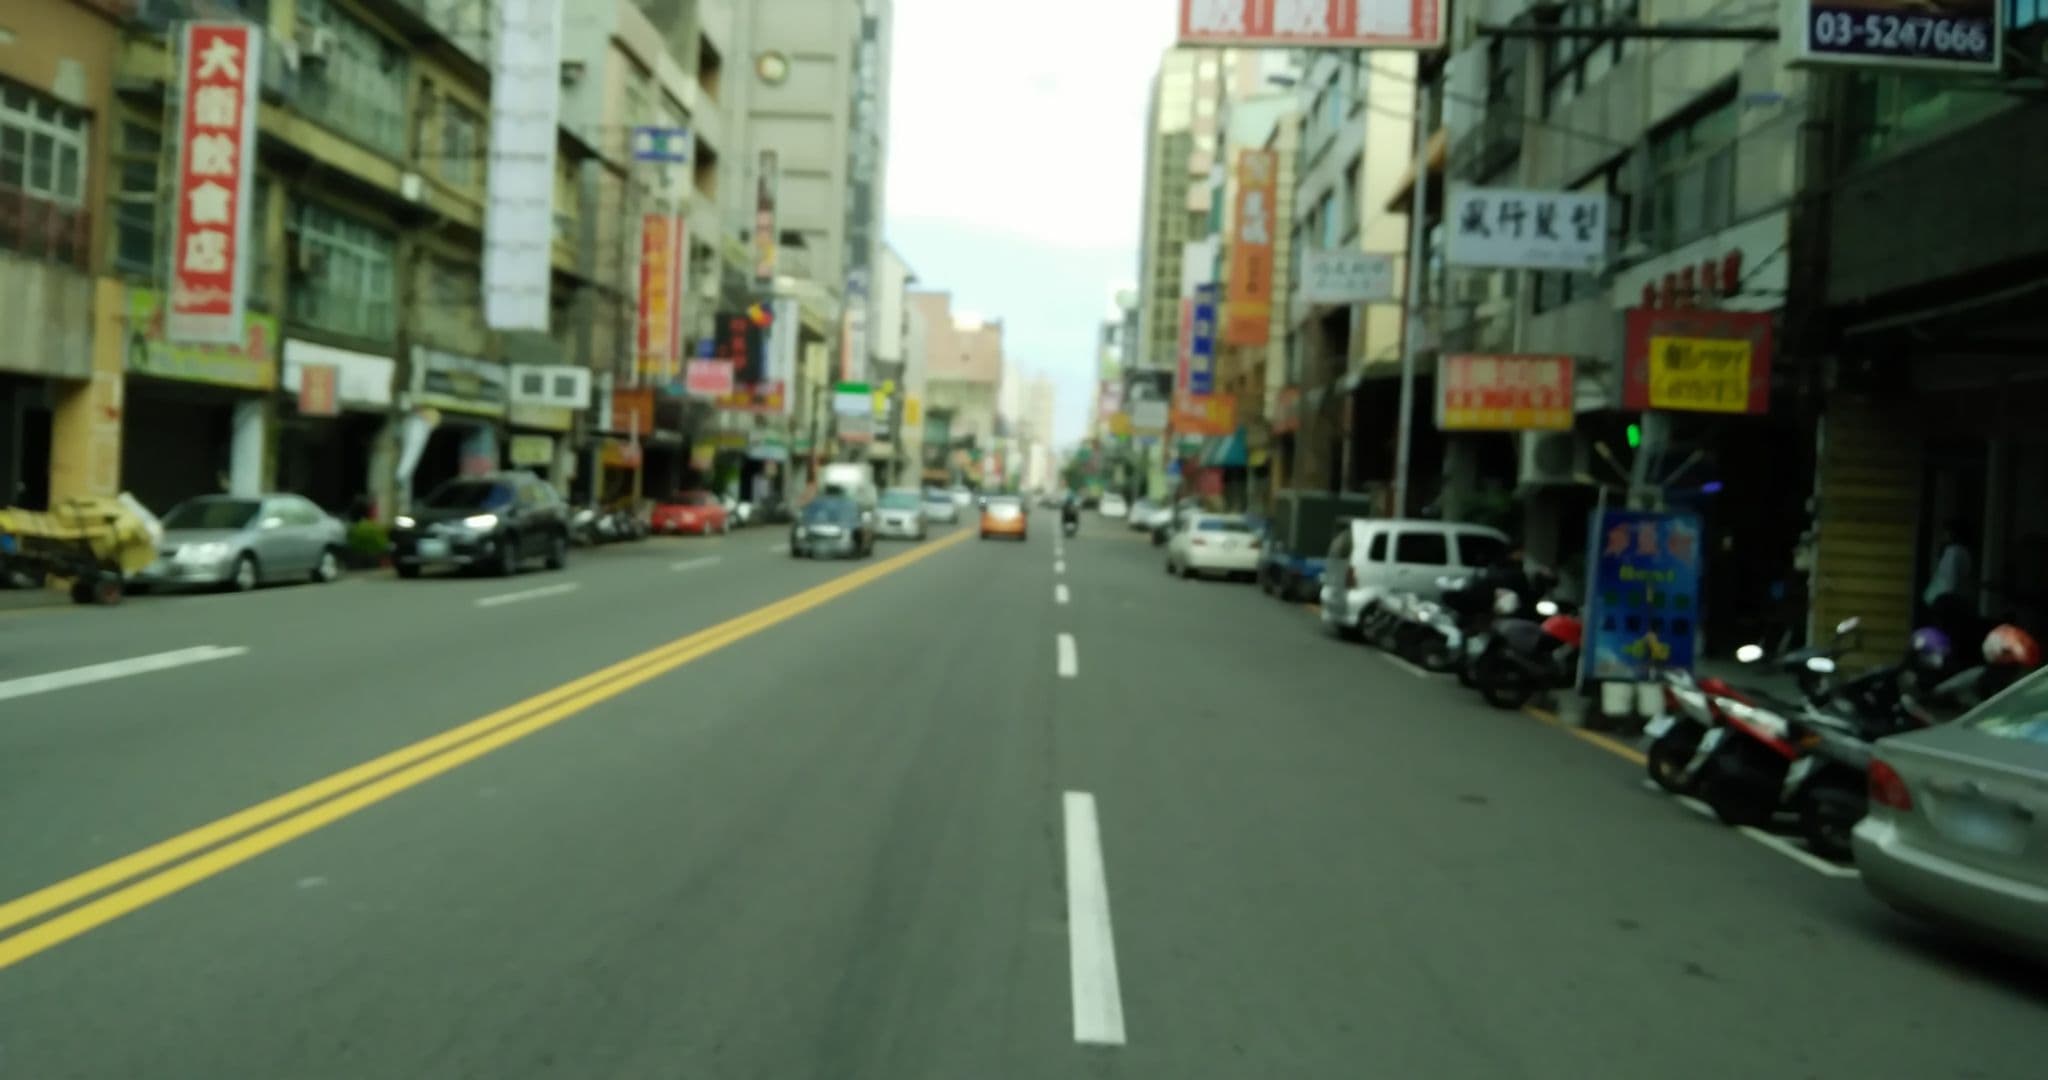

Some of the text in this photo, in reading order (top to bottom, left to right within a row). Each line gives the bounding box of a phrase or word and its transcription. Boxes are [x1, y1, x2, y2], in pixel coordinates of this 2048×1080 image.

[1815, 11, 1987, 51] 03-5247666
[184, 36, 240, 272] 大衛飲食店
